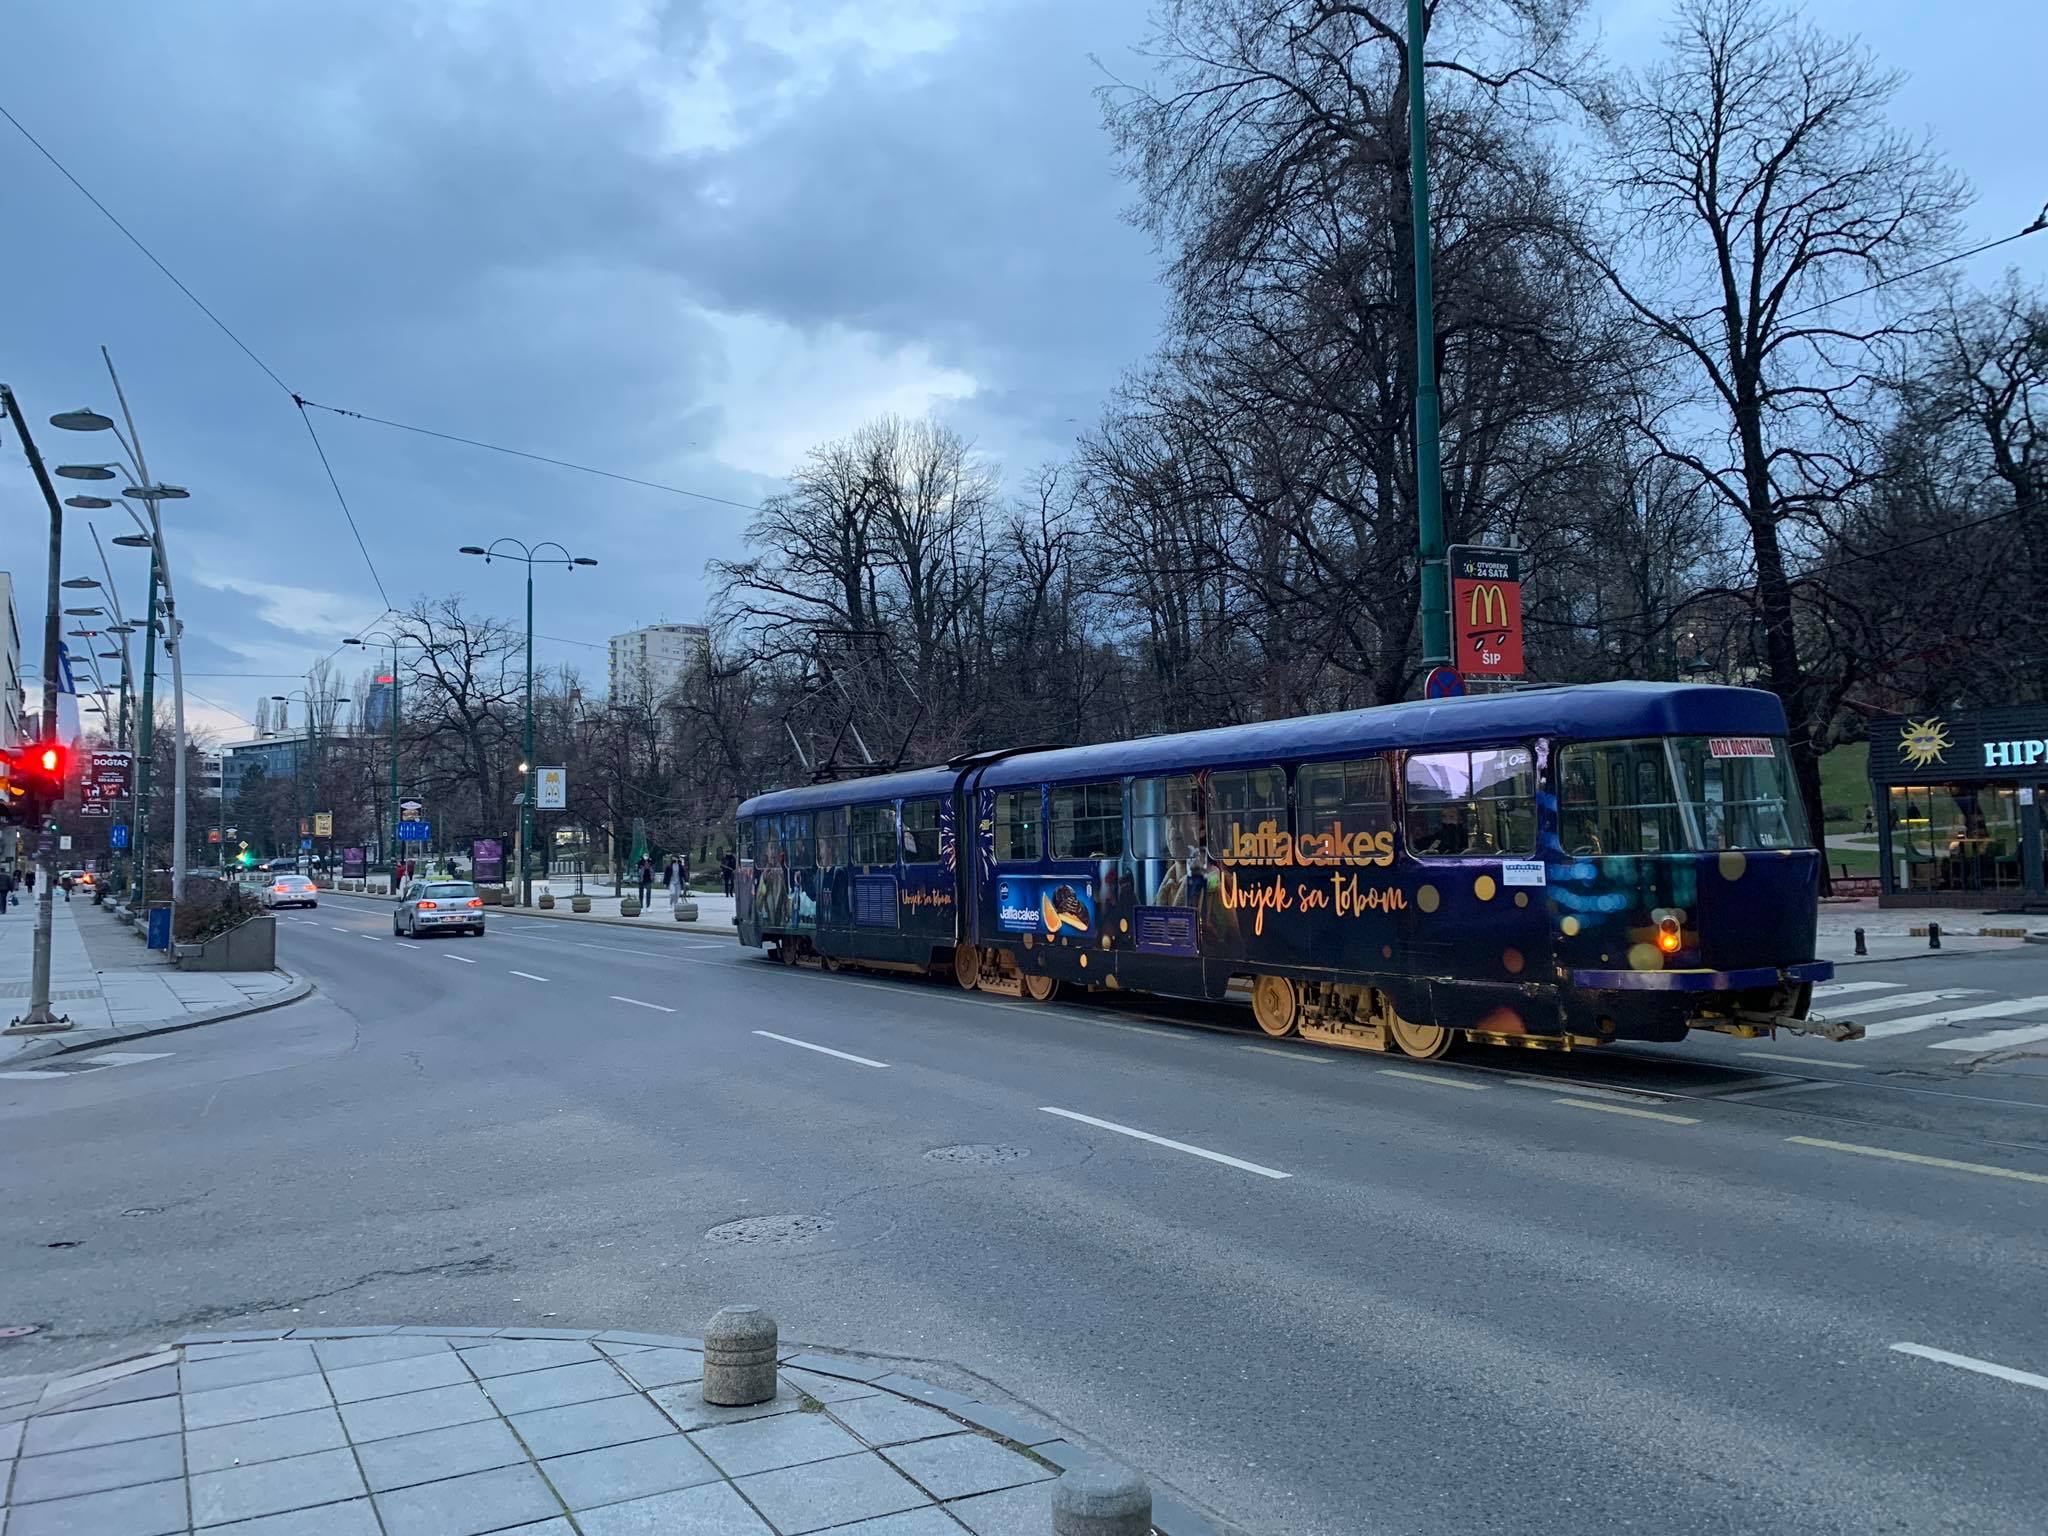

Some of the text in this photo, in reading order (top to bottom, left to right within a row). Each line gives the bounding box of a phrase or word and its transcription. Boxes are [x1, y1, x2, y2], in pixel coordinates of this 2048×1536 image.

[1477, 562, 1509, 570] OTVORENO
[1477, 568, 1509, 578] 24 SATA
[1482, 649, 1501, 665] ŠIP
[1295, 821, 1394, 867] cakes
[1220, 871, 1407, 936] Uvijek sa tobom
[1018, 907, 1040, 922] cakes
